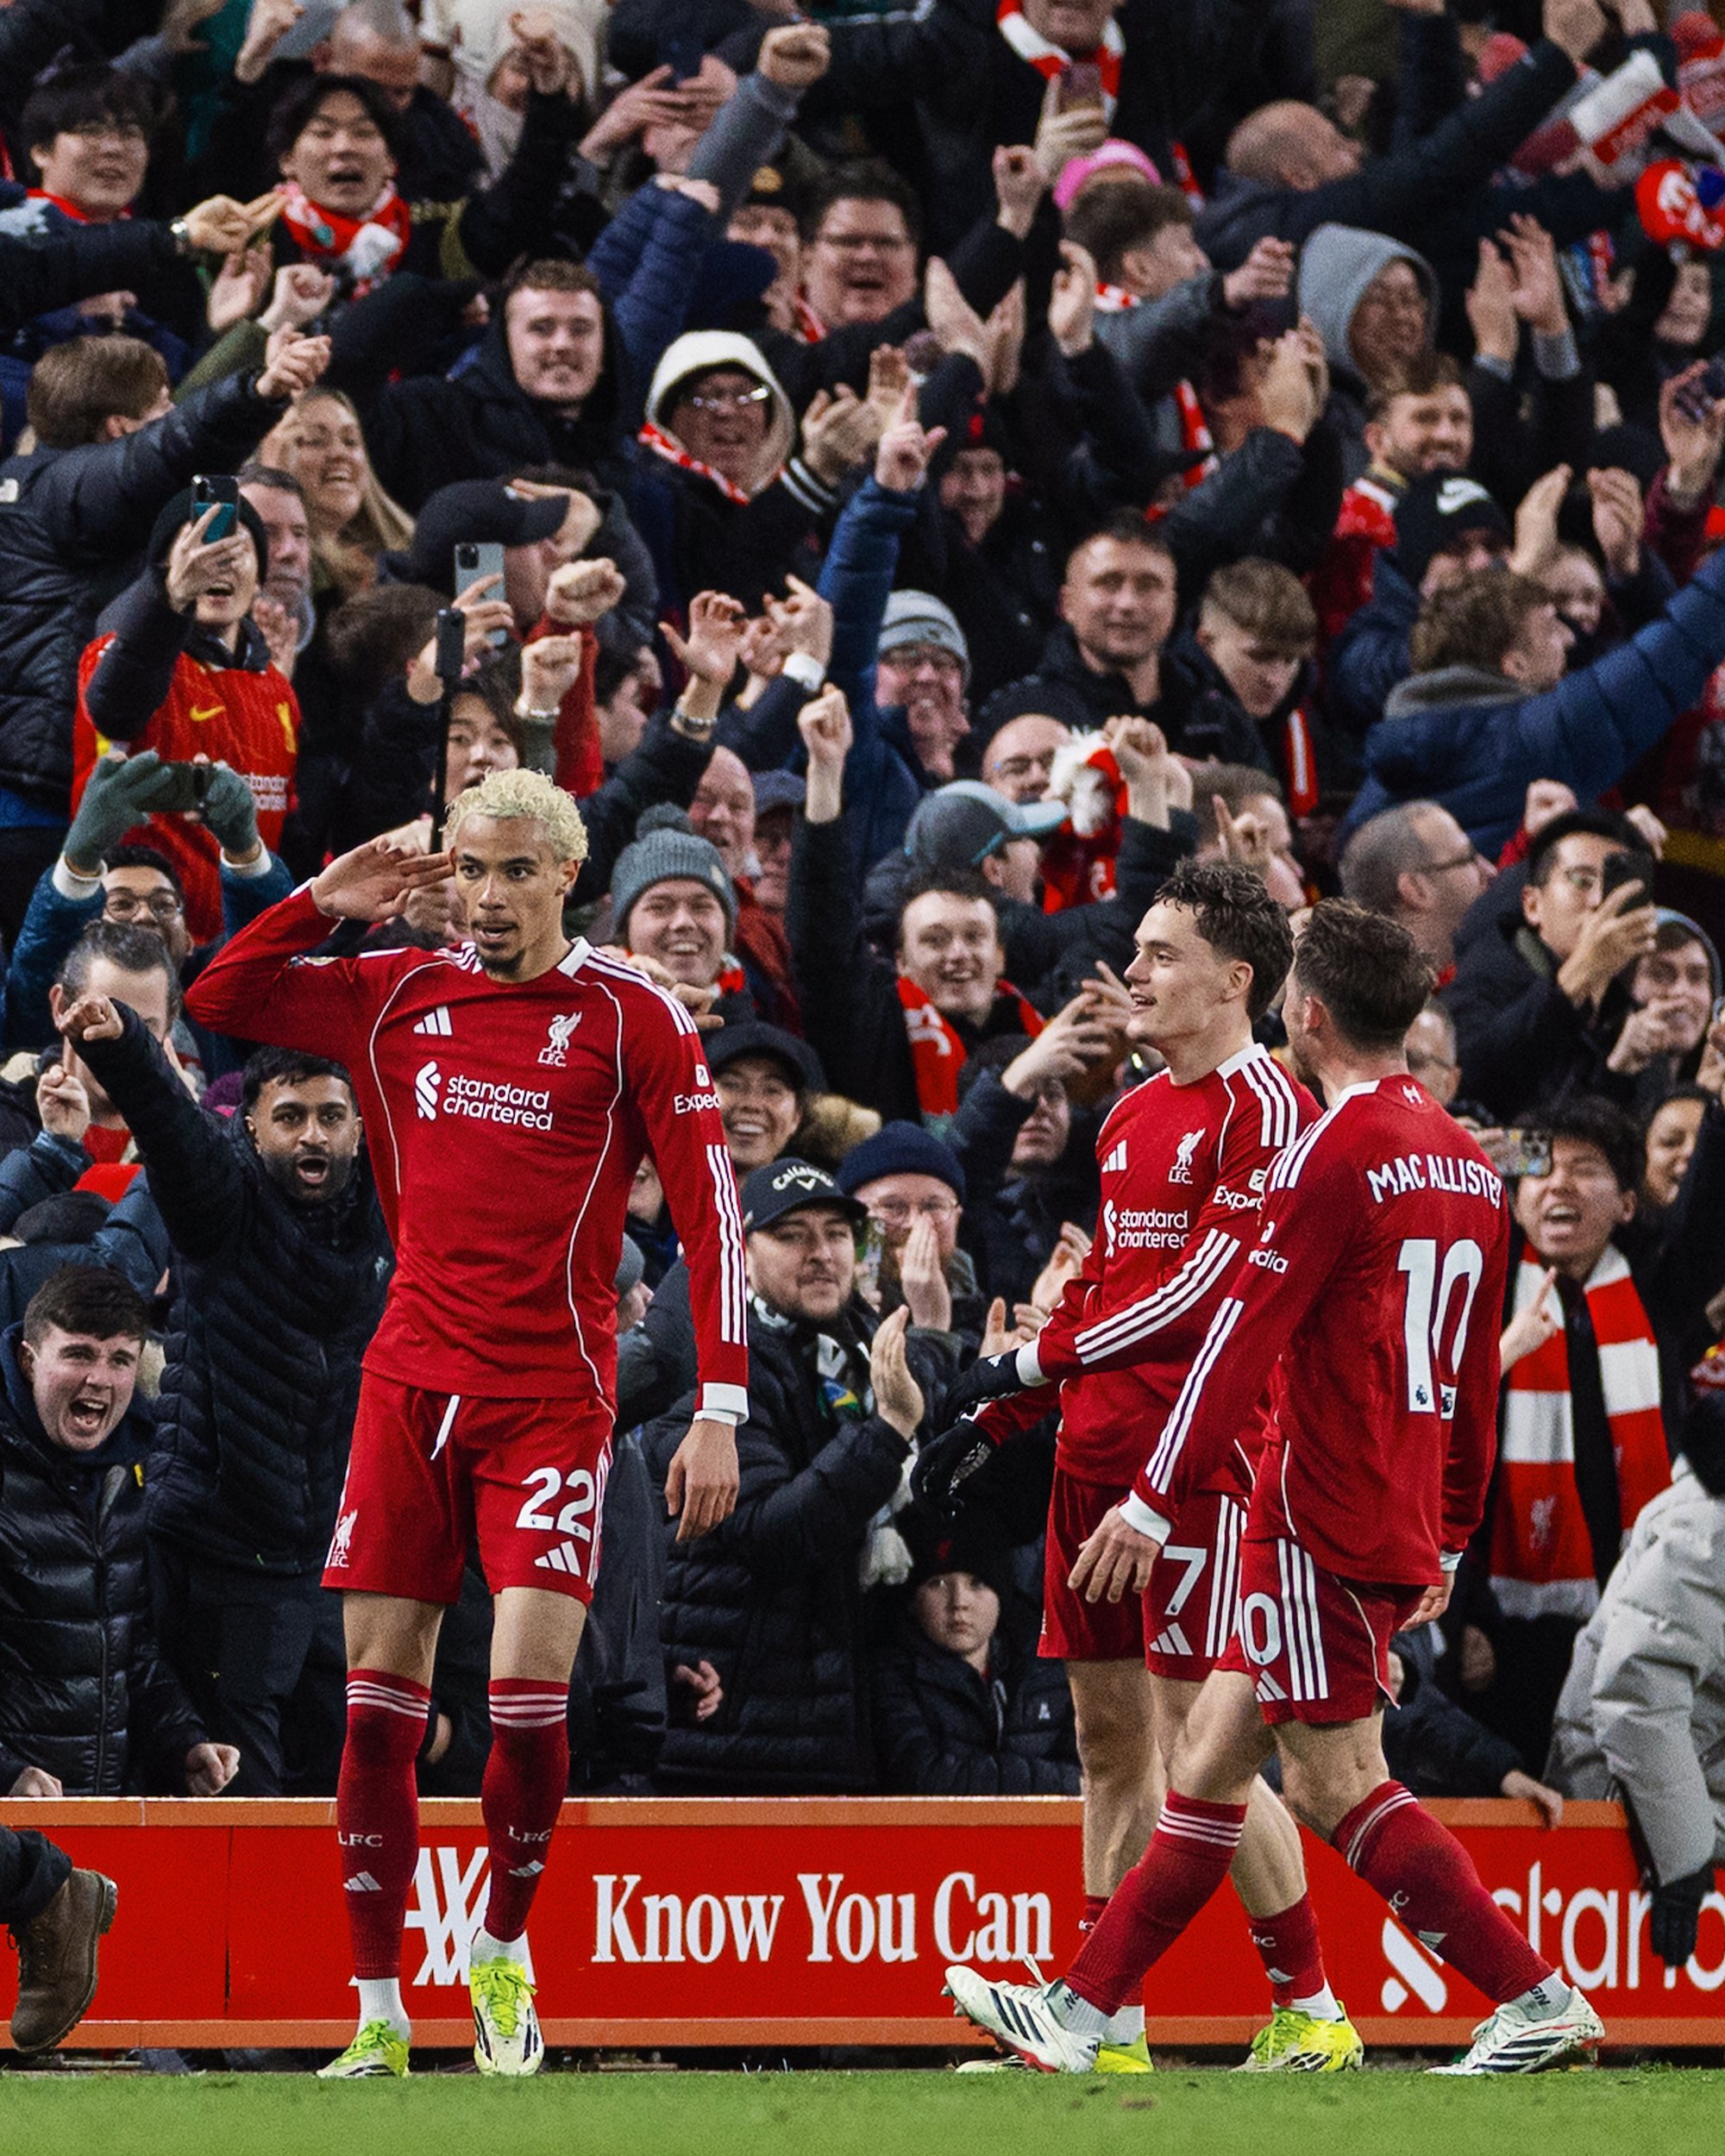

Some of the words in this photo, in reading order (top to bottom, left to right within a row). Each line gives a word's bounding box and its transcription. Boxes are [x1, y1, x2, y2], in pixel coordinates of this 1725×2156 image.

[442, 1094, 554, 1131] chartered
[446, 1075, 550, 1110] standard
[1366, 1153, 1427, 1203] MAC
[1119, 1208, 1189, 1230] standard
[1397, 1238, 1484, 1420] 10
[516, 1466, 595, 1543] 22
[1162, 1545, 1208, 1616] 7
[337, 1829, 384, 1848] LFC
[508, 1824, 553, 1844] LFC
[592, 1874, 785, 1963] Know
[797, 1873, 919, 1963] You
[933, 1871, 1054, 1963] Can
